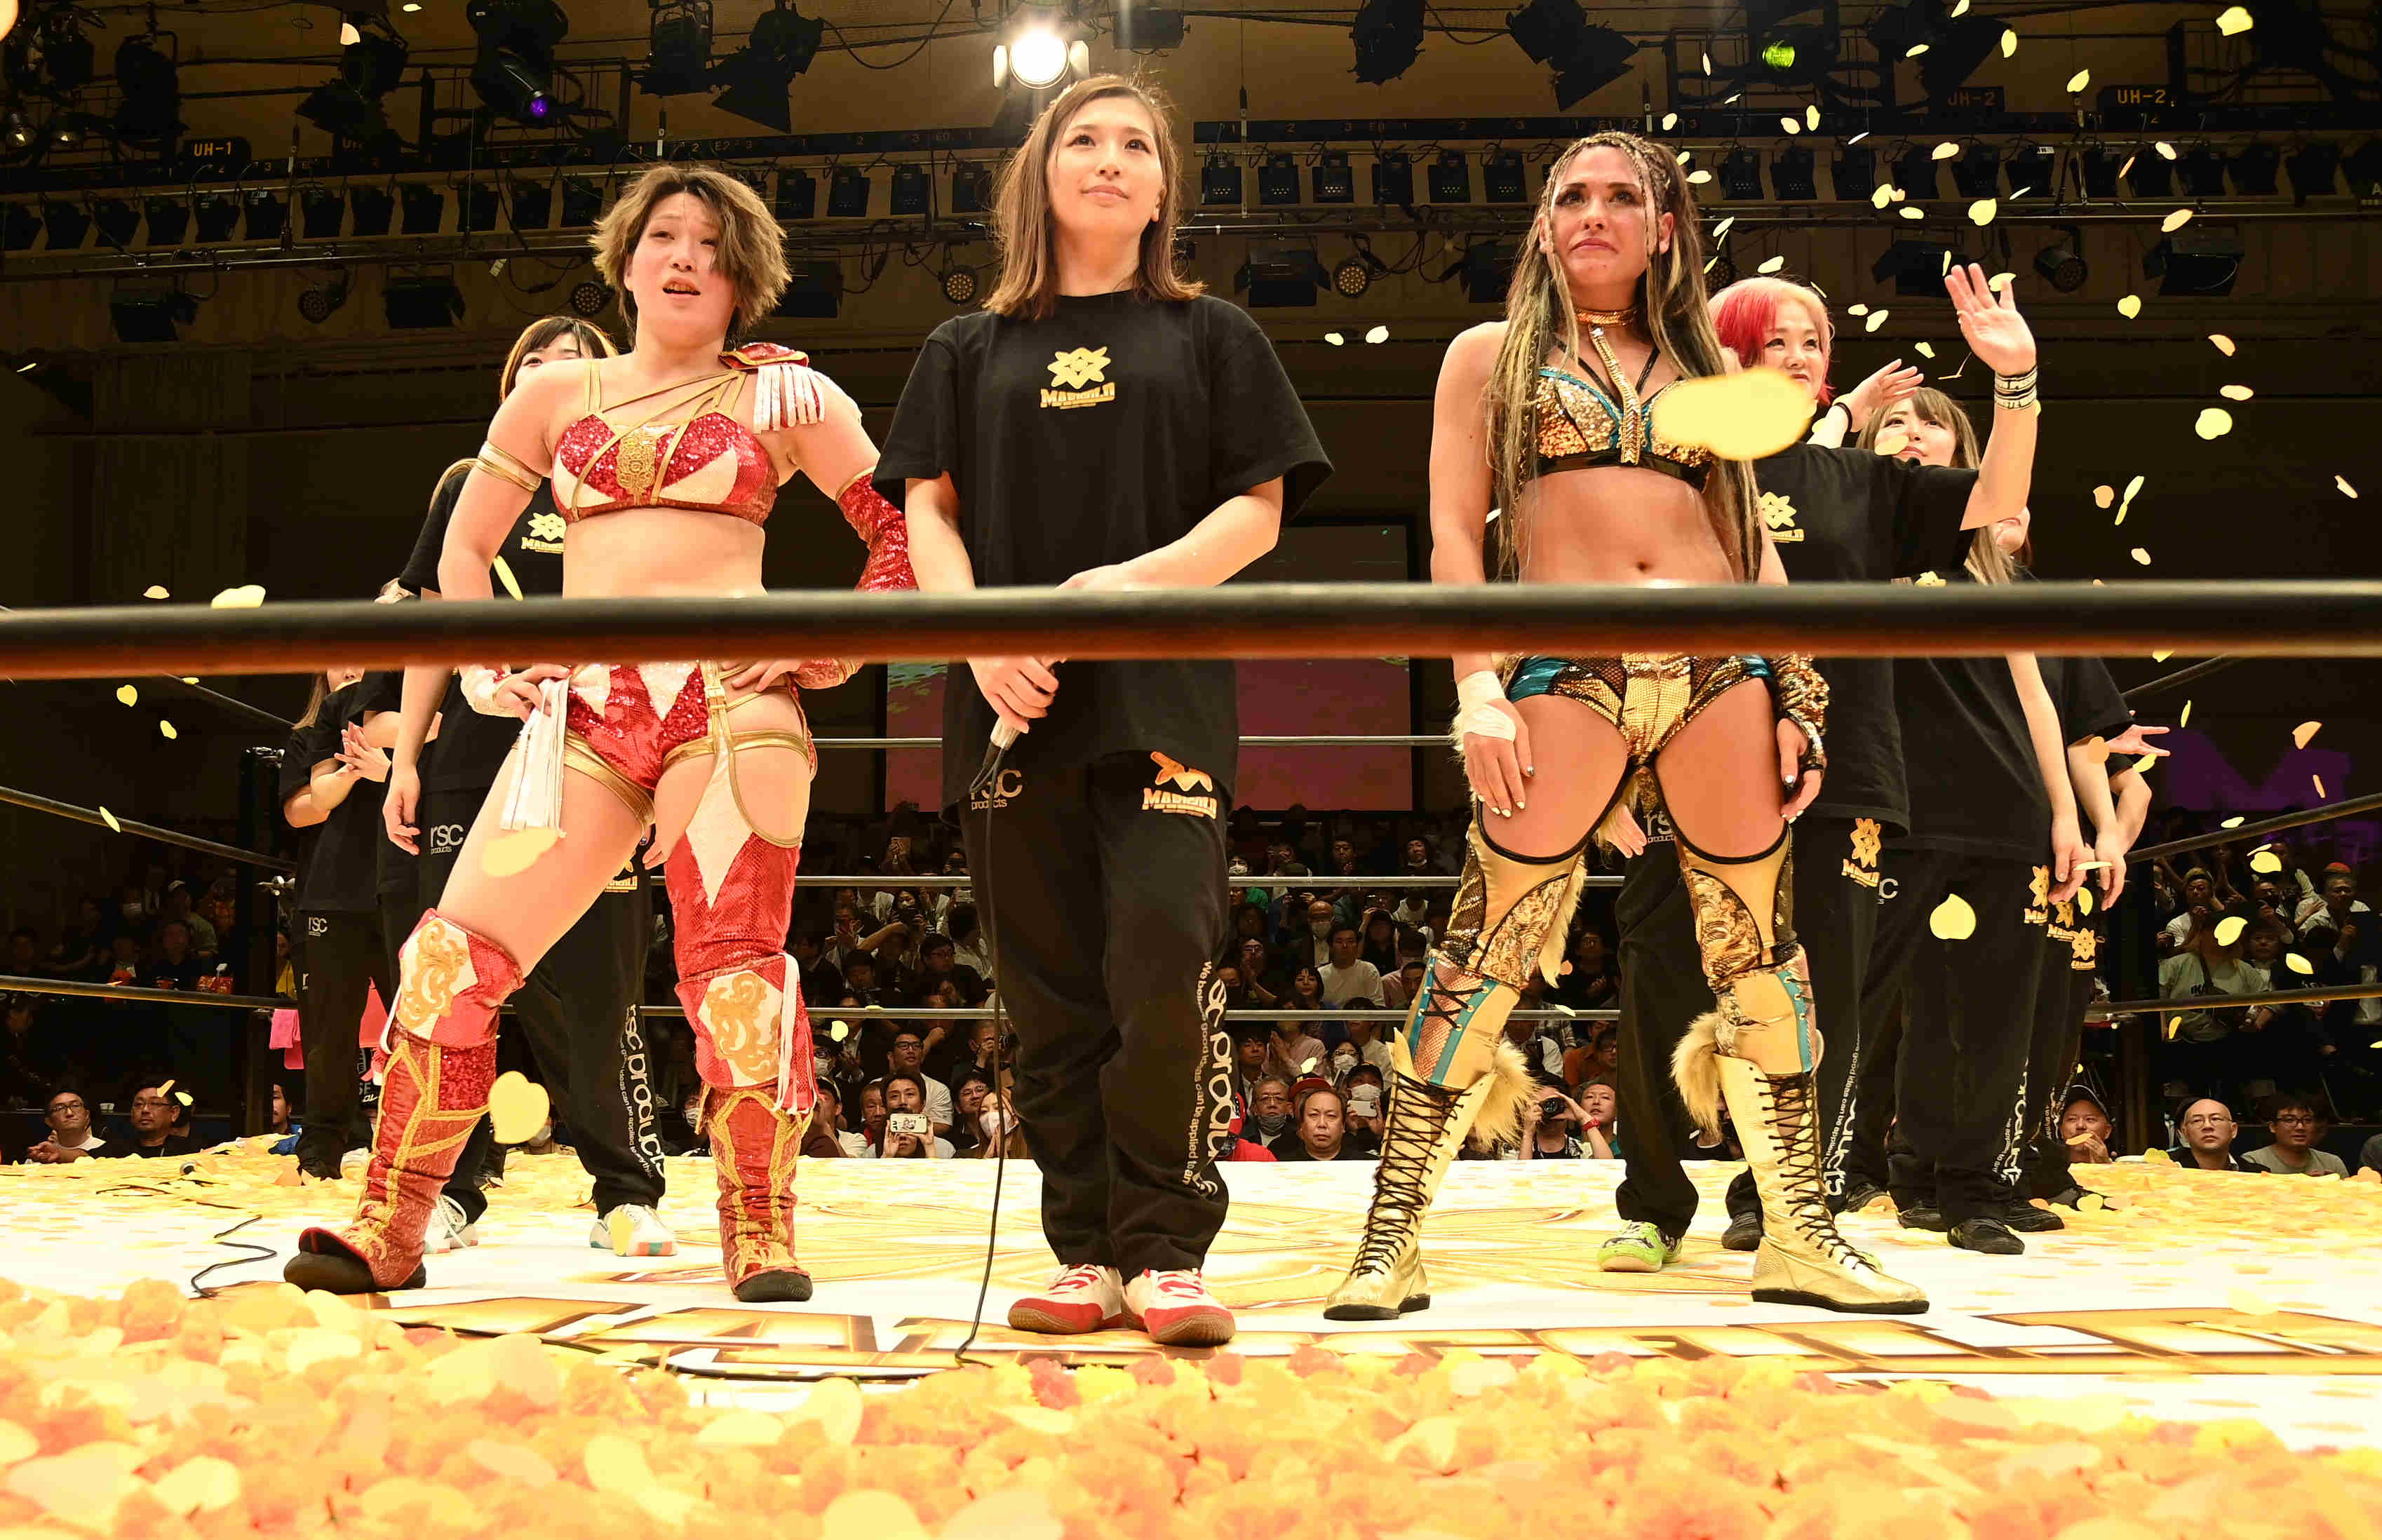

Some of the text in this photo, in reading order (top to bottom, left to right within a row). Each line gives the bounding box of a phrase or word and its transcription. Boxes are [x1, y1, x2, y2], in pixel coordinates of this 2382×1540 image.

[2116, 88, 2167, 104] UH-2
[193, 142, 233, 156] UH-1
[430, 824, 464, 847] rsc
[1187, 1118, 1199, 1159] applied
